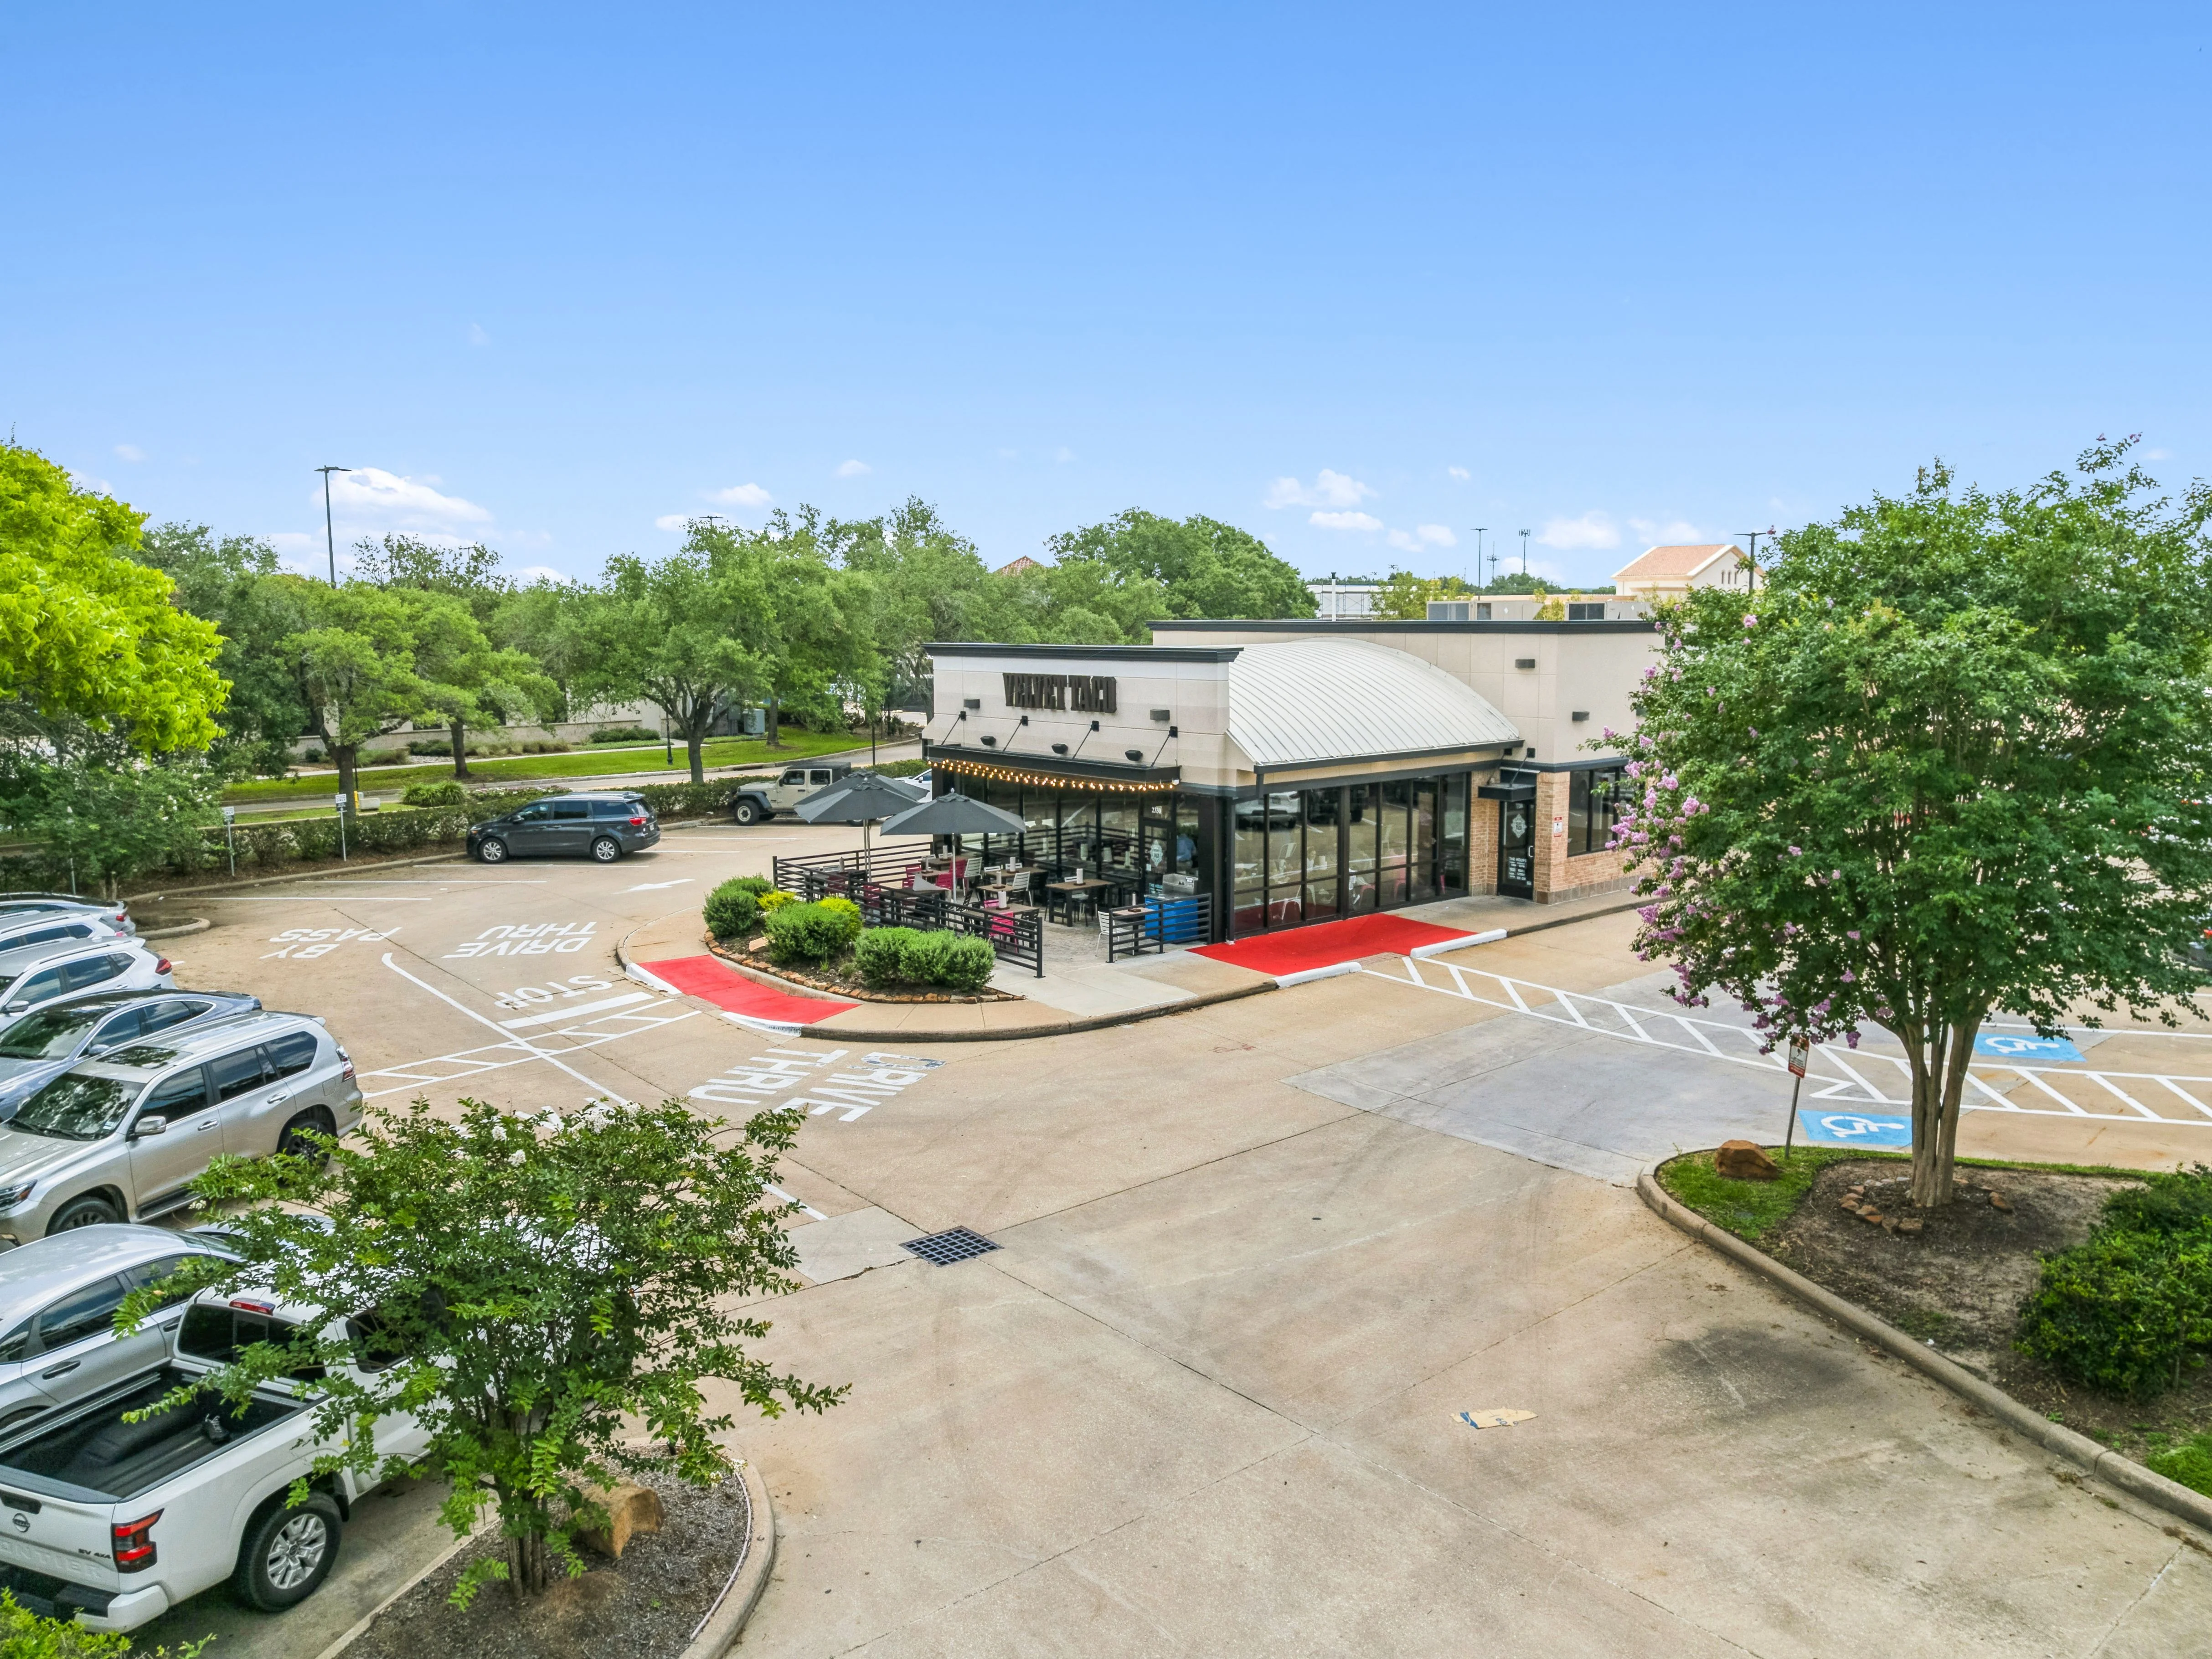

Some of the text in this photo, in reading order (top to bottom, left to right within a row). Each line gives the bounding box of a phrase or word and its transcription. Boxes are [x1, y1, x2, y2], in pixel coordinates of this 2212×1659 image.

[1003, 673, 1117, 714] VELVET TACO
[269, 927, 402, 942] PASS
[475, 922, 597, 939] THRU
[258, 944, 340, 959] BY
[441, 937, 592, 958] DRIVE
[494, 975, 613, 1009] STOP
[687, 1048, 849, 1104] THRU
[774, 1051, 947, 1122] DRIVE
